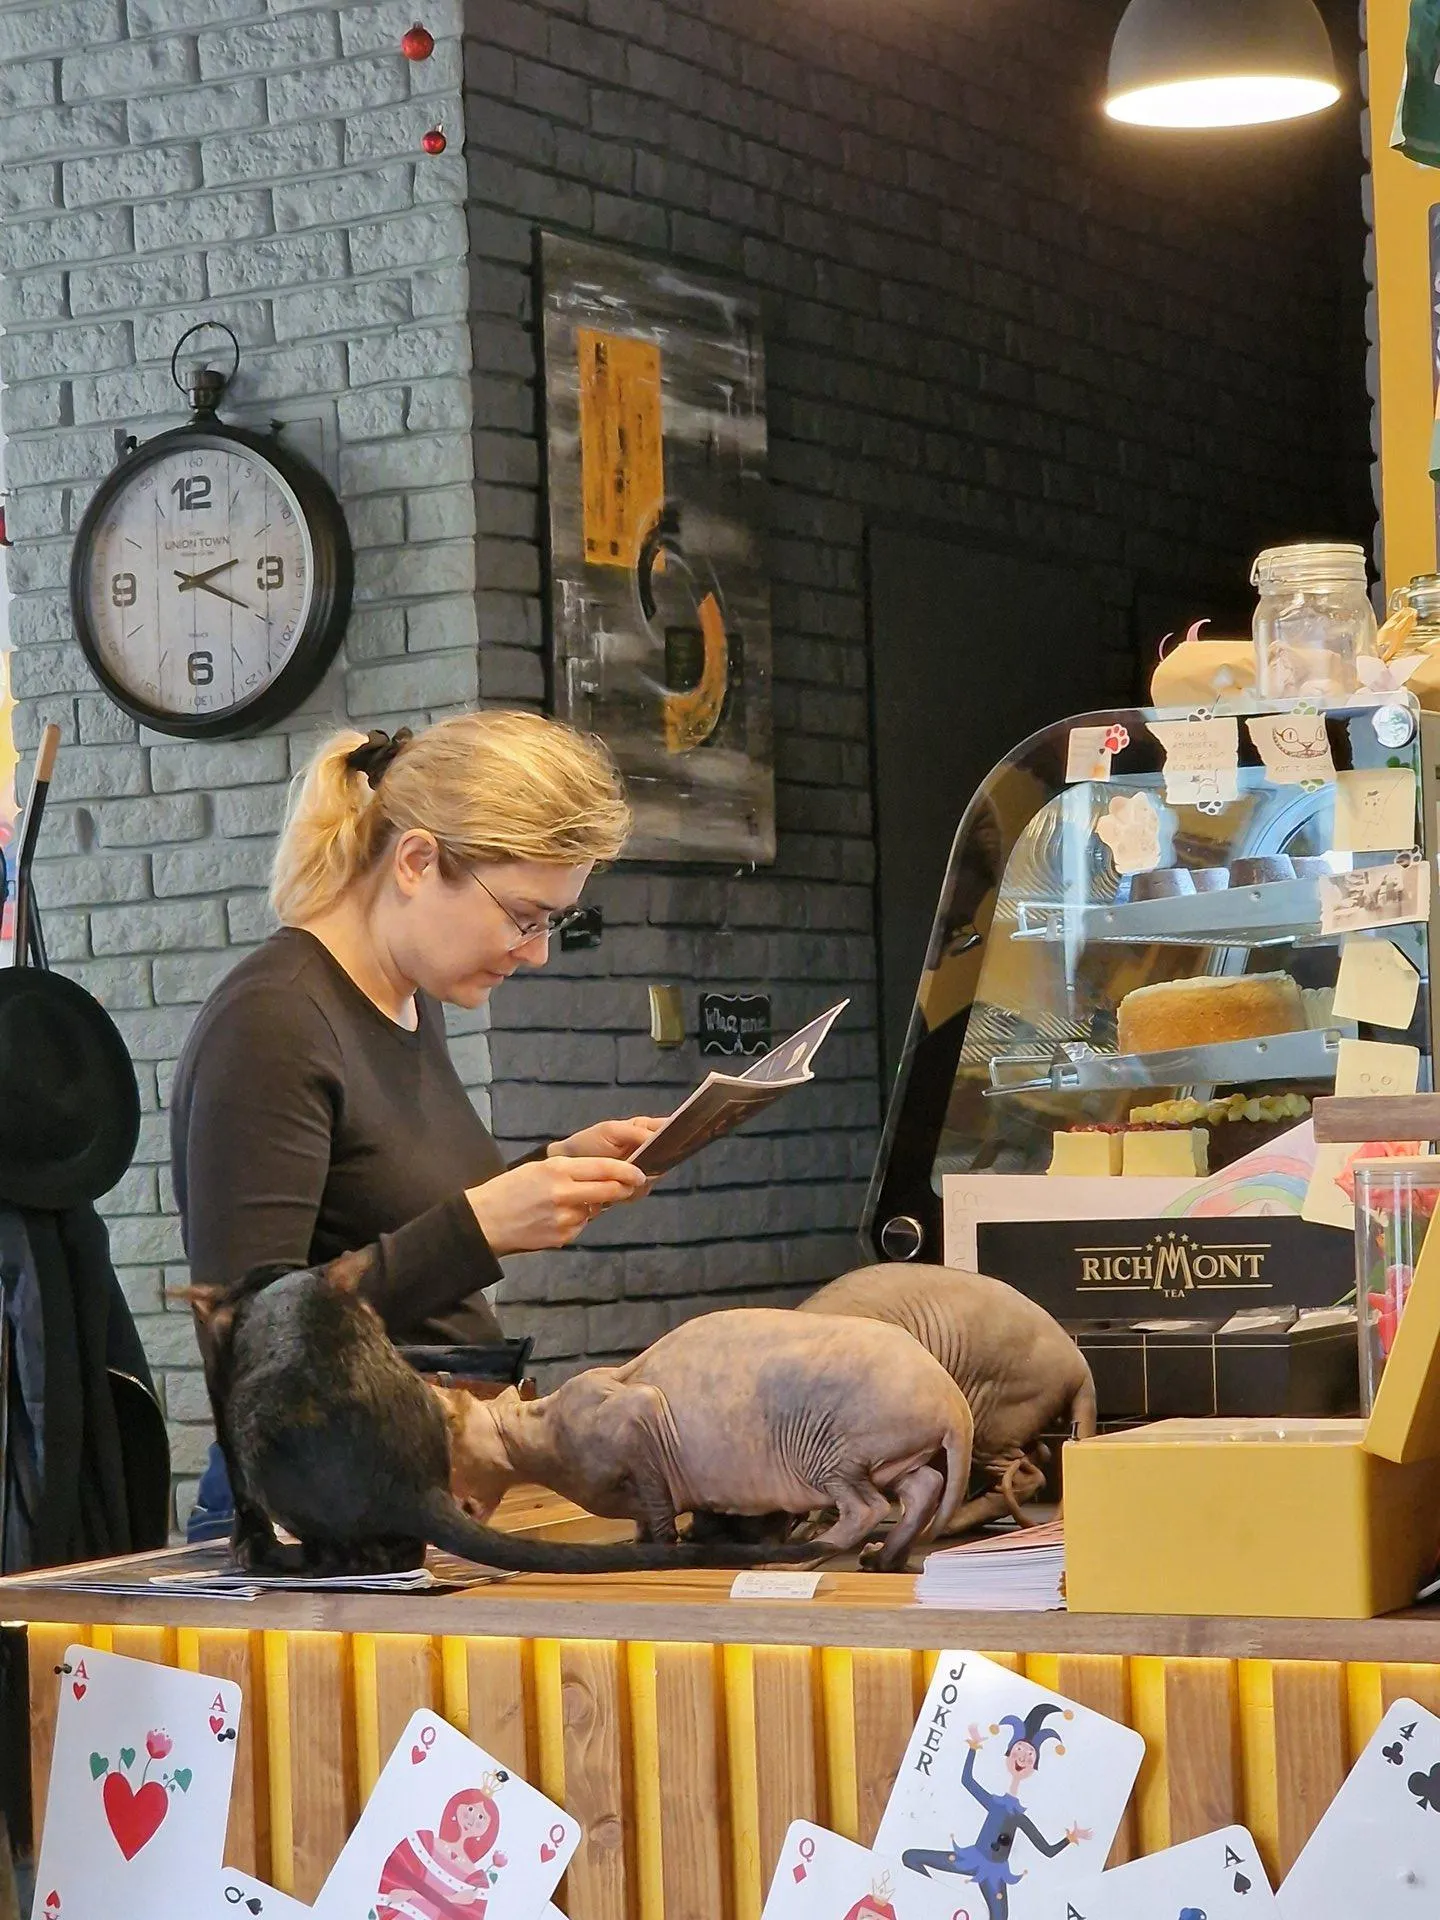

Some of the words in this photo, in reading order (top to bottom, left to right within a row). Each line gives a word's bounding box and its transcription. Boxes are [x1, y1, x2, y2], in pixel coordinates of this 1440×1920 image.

[171, 475, 212, 511] 12
[164, 538, 197, 551] UNION
[199, 534, 232, 548] TOWN
[257, 555, 284, 591] 3
[111, 572, 137, 607] 9
[187, 651, 214, 686] 6
[1082, 1242, 1265, 1290] RICHMONT
[1163, 1288, 1186, 1299] TEA
[74, 1659, 90, 1680] A
[208, 1692, 228, 1713] A
[914, 1662, 967, 1777] JOKER
[1399, 1721, 1419, 1742] 4
[420, 1726, 437, 1750] Q
[549, 1824, 566, 1849] Q
[798, 1837, 816, 1863] Q
[1223, 1844, 1246, 1869] A
[224, 1886, 245, 1904] Q
